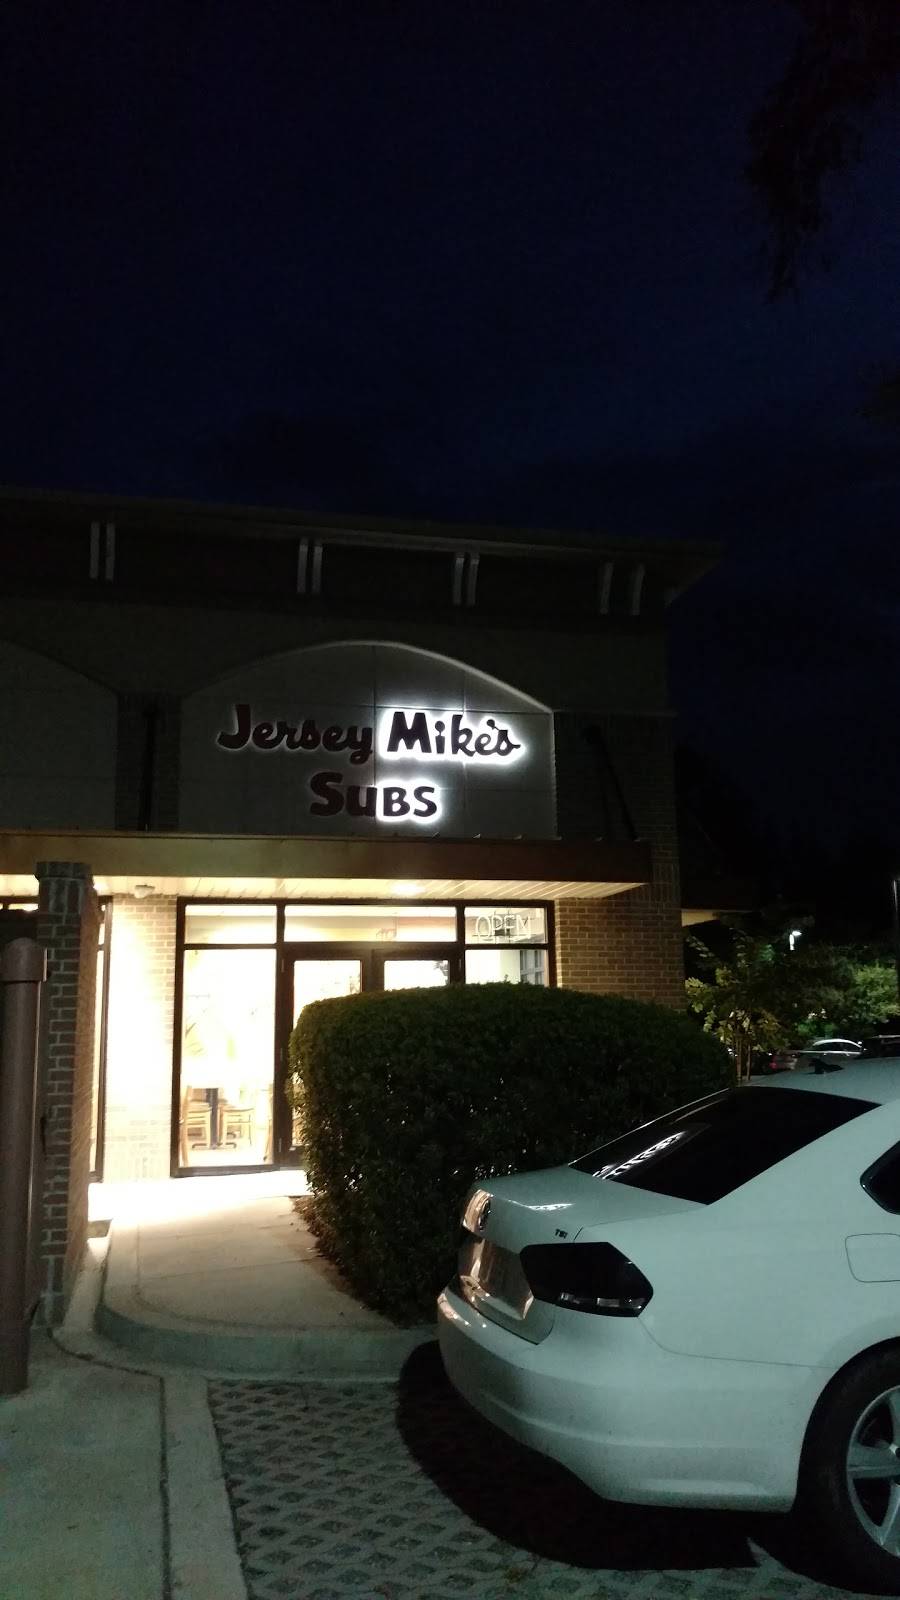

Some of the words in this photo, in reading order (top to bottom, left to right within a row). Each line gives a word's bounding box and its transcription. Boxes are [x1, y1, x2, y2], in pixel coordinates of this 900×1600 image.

[217, 704, 373, 765] Jersey
[387, 711, 521, 757] Mike's
[475, 914, 532, 939] OPEN
